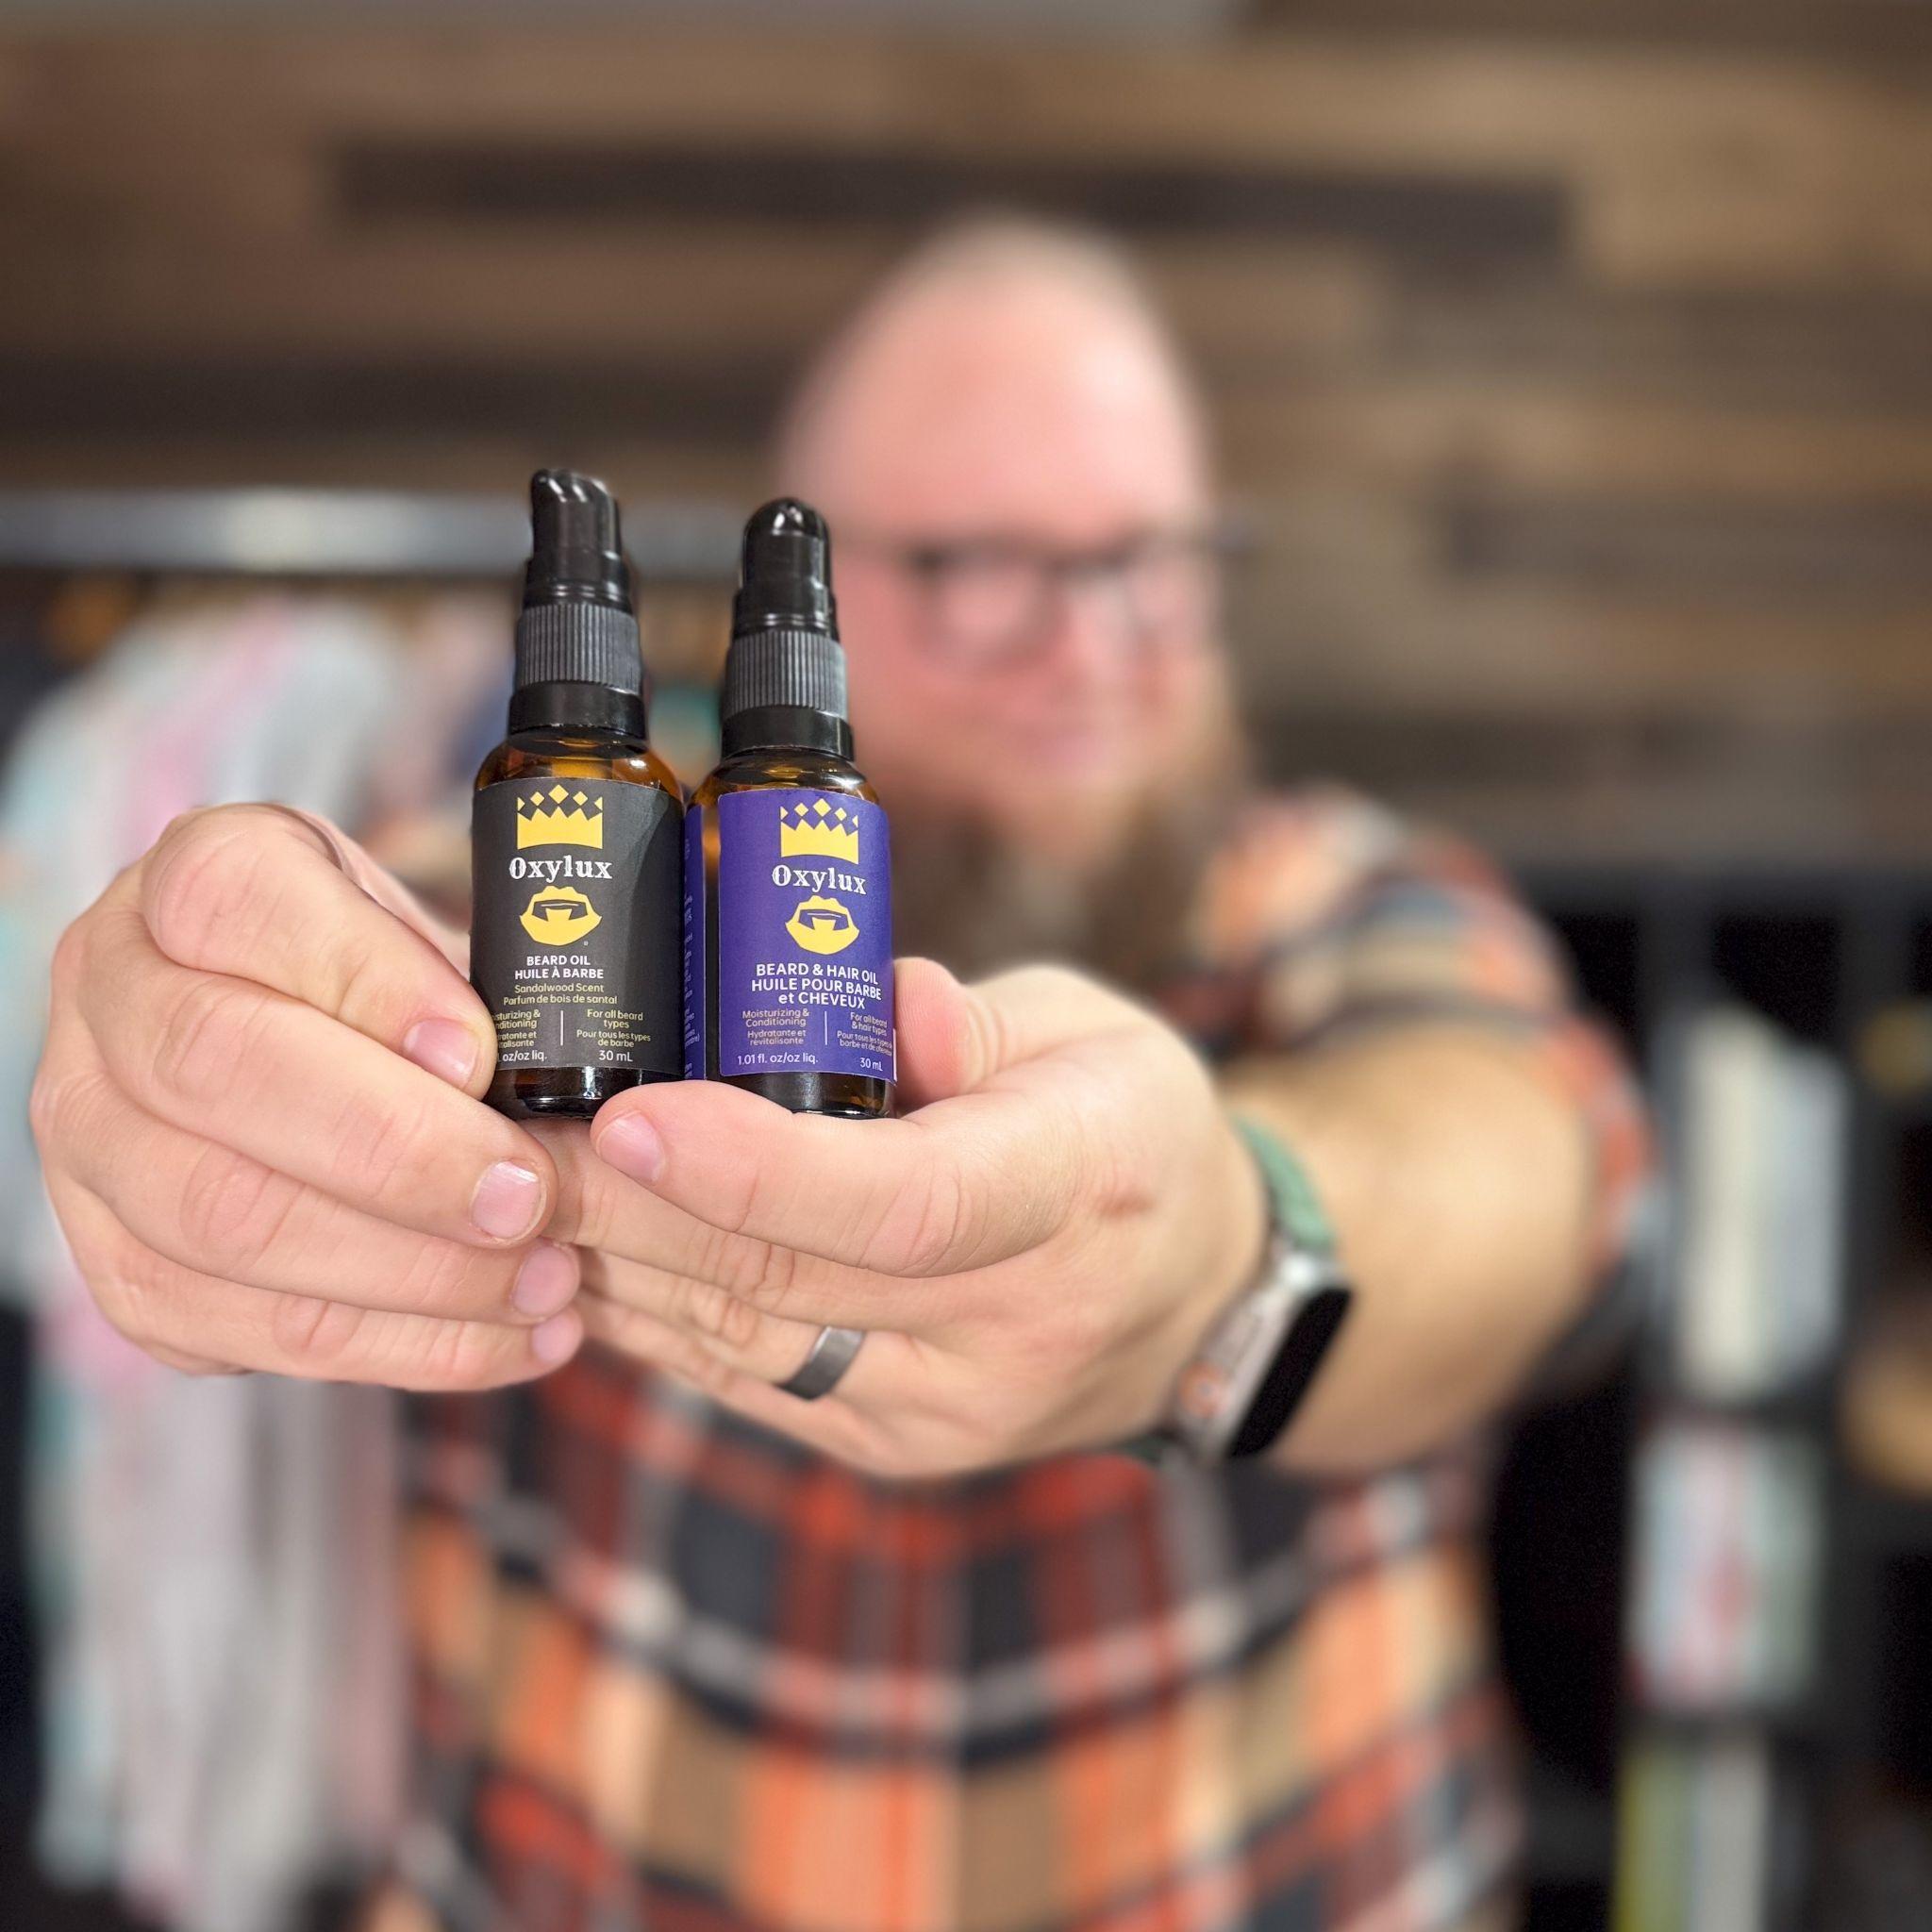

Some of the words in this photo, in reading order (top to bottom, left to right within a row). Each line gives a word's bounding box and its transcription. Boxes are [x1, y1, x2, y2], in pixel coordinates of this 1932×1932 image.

[509, 855, 612, 883] Oxylux
[772, 864, 866, 894] Oxylux
[526, 955, 567, 967] BEARD
[570, 955, 591, 966] OIL
[514, 968, 550, 980] HUILE
[552, 966, 560, 978] À
[562, 968, 605, 979] BARBE
[757, 962, 809, 976] BEARD
[812, 963, 824, 976] &
[826, 965, 859, 981] HAIR
[861, 970, 878, 985] OIL
[514, 983, 575, 994] Sandalwood
[575, 982, 605, 993] Scent
[752, 977, 798, 991] HUILE
[802, 978, 843, 993] POUR
[845, 982, 882, 1001] BARBE
[503, 995, 535, 1007] Parfum
[536, 994, 548, 1004] de
[549, 993, 571, 1004] bois
[573, 993, 586, 1004] de
[587, 994, 618, 1005] santal
[778, 992, 795, 1005] et
[798, 991, 866, 1009] CHEVEUX
[533, 1008, 541, 1018] &
[587, 1008, 604, 1018] For
[604, 1009, 616, 1019] all
[617, 1009, 643, 1021] beard
[741, 1008, 801, 1019] Moisturizing
[802, 1008, 809, 1017] &
[850, 1011, 862, 1022] For
[603, 1019, 630, 1029] types
[745, 1017, 807, 1028] Conditioning
[528, 1030, 538, 1039] et
[576, 1028, 597, 1038] Pour
[598, 1030, 618, 1040] tous
[618, 1031, 630, 1040] les
[630, 1032, 652, 1042] types
[747, 1029, 797, 1039] Hydratante
[597, 1038, 609, 1046] de
[609, 1039, 635, 1048] barbe
[750, 1037, 805, 1046] revitalisante
[502, 1050, 530, 1062] oz/oz
[531, 1049, 548, 1062] liq.
[598, 1050, 614, 1061] 30
[616, 1052, 634, 1062] mL
[737, 1054, 756, 1065] 1.01
[757, 1053, 768, 1064] fl.
[769, 1052, 801, 1064] oz/oz
[802, 1052, 819, 1065] liq.
[859, 1057, 872, 1069] 30
[872, 1061, 884, 1072] mL
